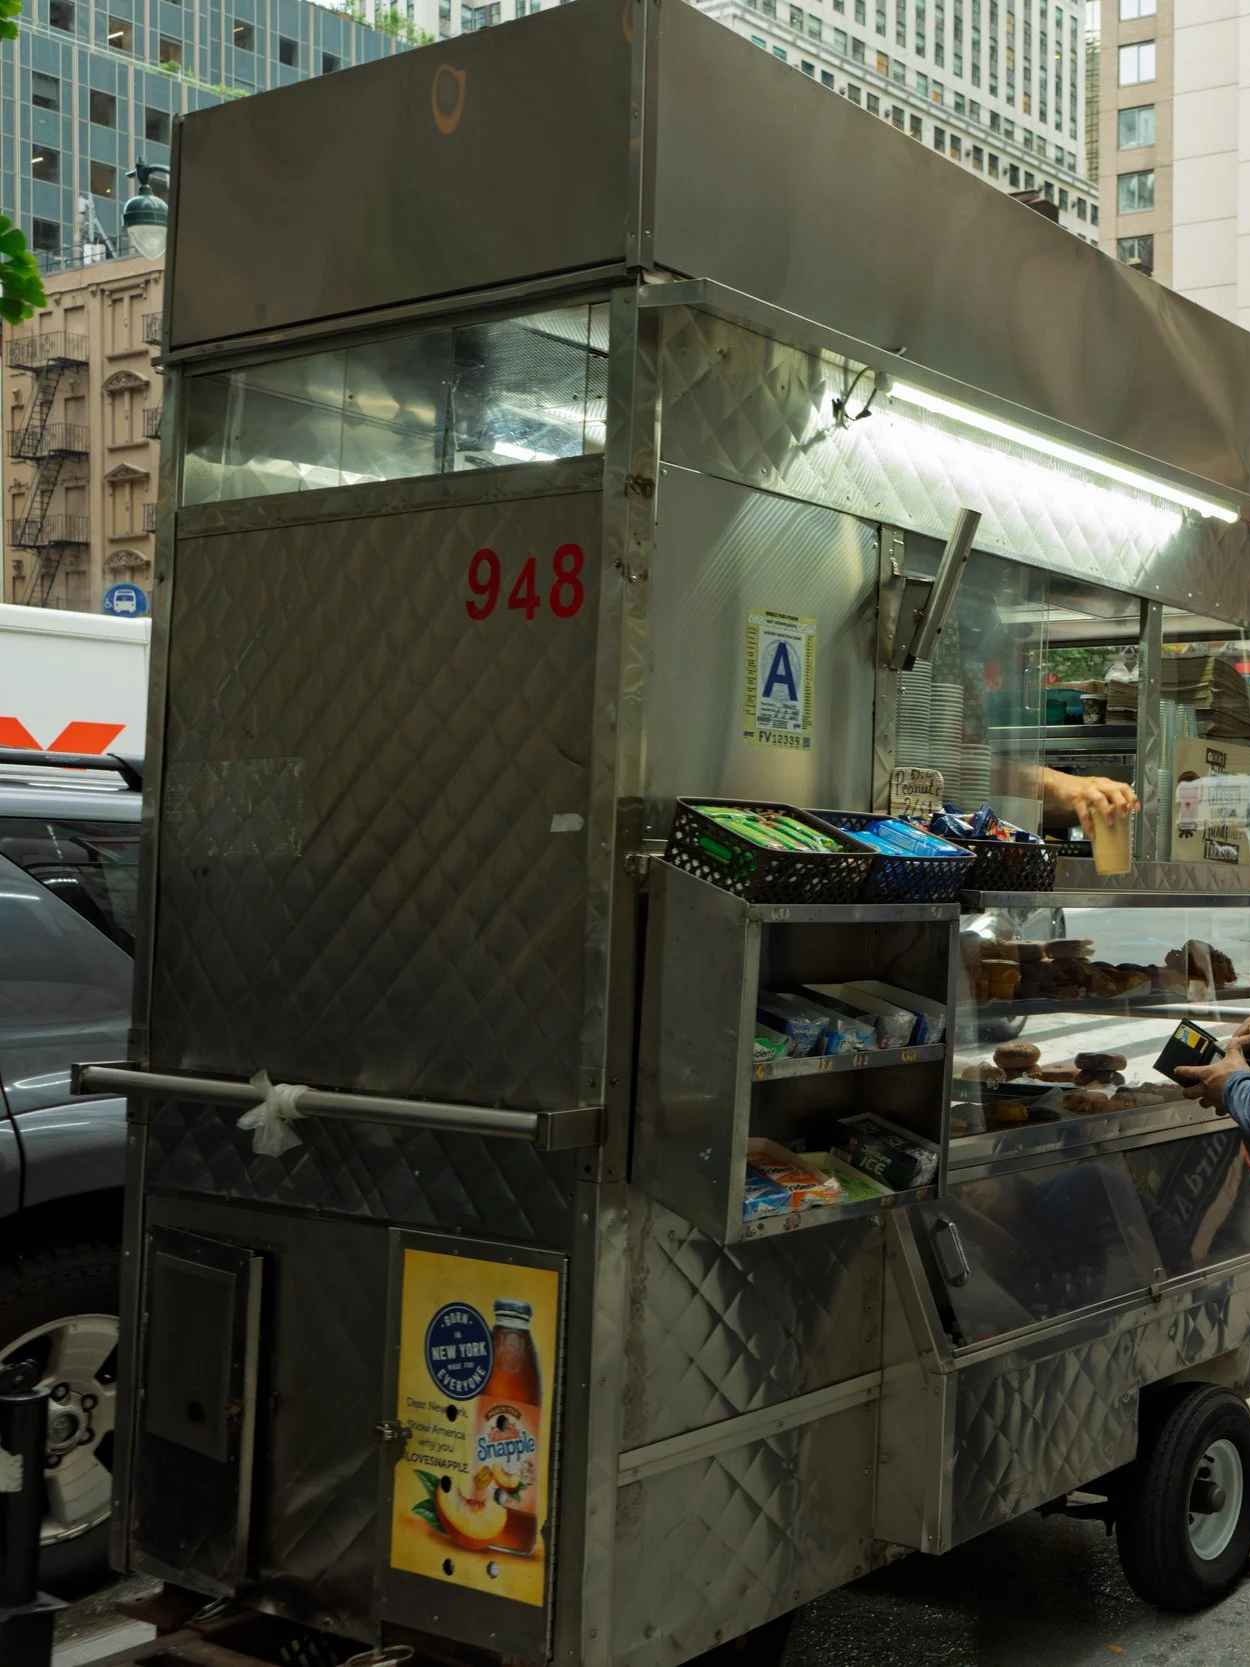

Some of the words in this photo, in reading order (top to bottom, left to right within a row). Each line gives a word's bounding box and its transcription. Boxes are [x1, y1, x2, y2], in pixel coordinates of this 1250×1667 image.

[465, 543, 585, 621] 948
[762, 642, 798, 701] A
[896, 771, 940, 797] Peanuts
[759, 1167, 794, 1176] Trident
[860, 1156, 886, 1175] ICE
[443, 1311, 469, 1327] BORN
[431, 1345, 457, 1361] NEW
[460, 1341, 488, 1358] YORK
[437, 1365, 487, 1392] EVERYONE
[406, 1397, 426, 1409] Dear
[477, 1431, 536, 1463] Snapple
